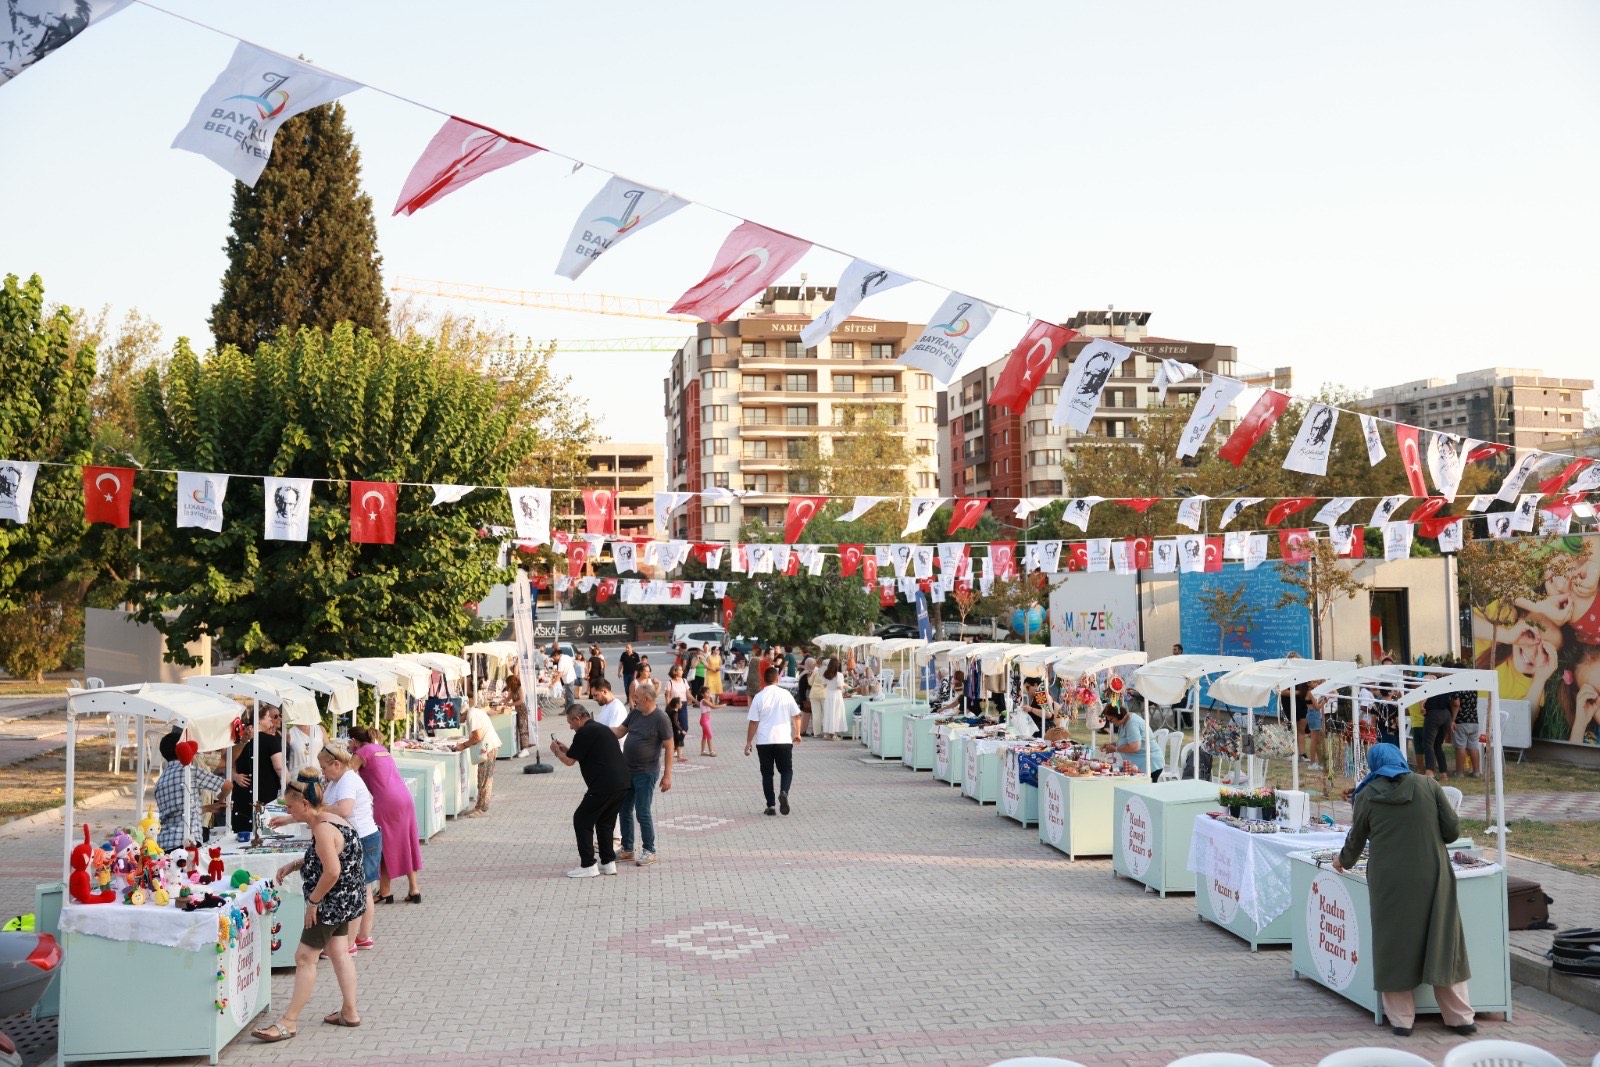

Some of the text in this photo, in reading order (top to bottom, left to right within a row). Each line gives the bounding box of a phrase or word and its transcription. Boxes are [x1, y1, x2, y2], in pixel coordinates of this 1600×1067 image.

[211, 107, 268, 143] BAYRKLI
[844, 323, 877, 333] SİTESİ
[920, 335, 963, 360] BAYRAKLI
[1158, 345, 1189, 354] SİTESİ
[592, 624, 627, 634] HASKALE
[1318, 894, 1346, 921] Kadın
[1319, 913, 1346, 944] Emeği
[1318, 931, 1347, 961] Pazarı
